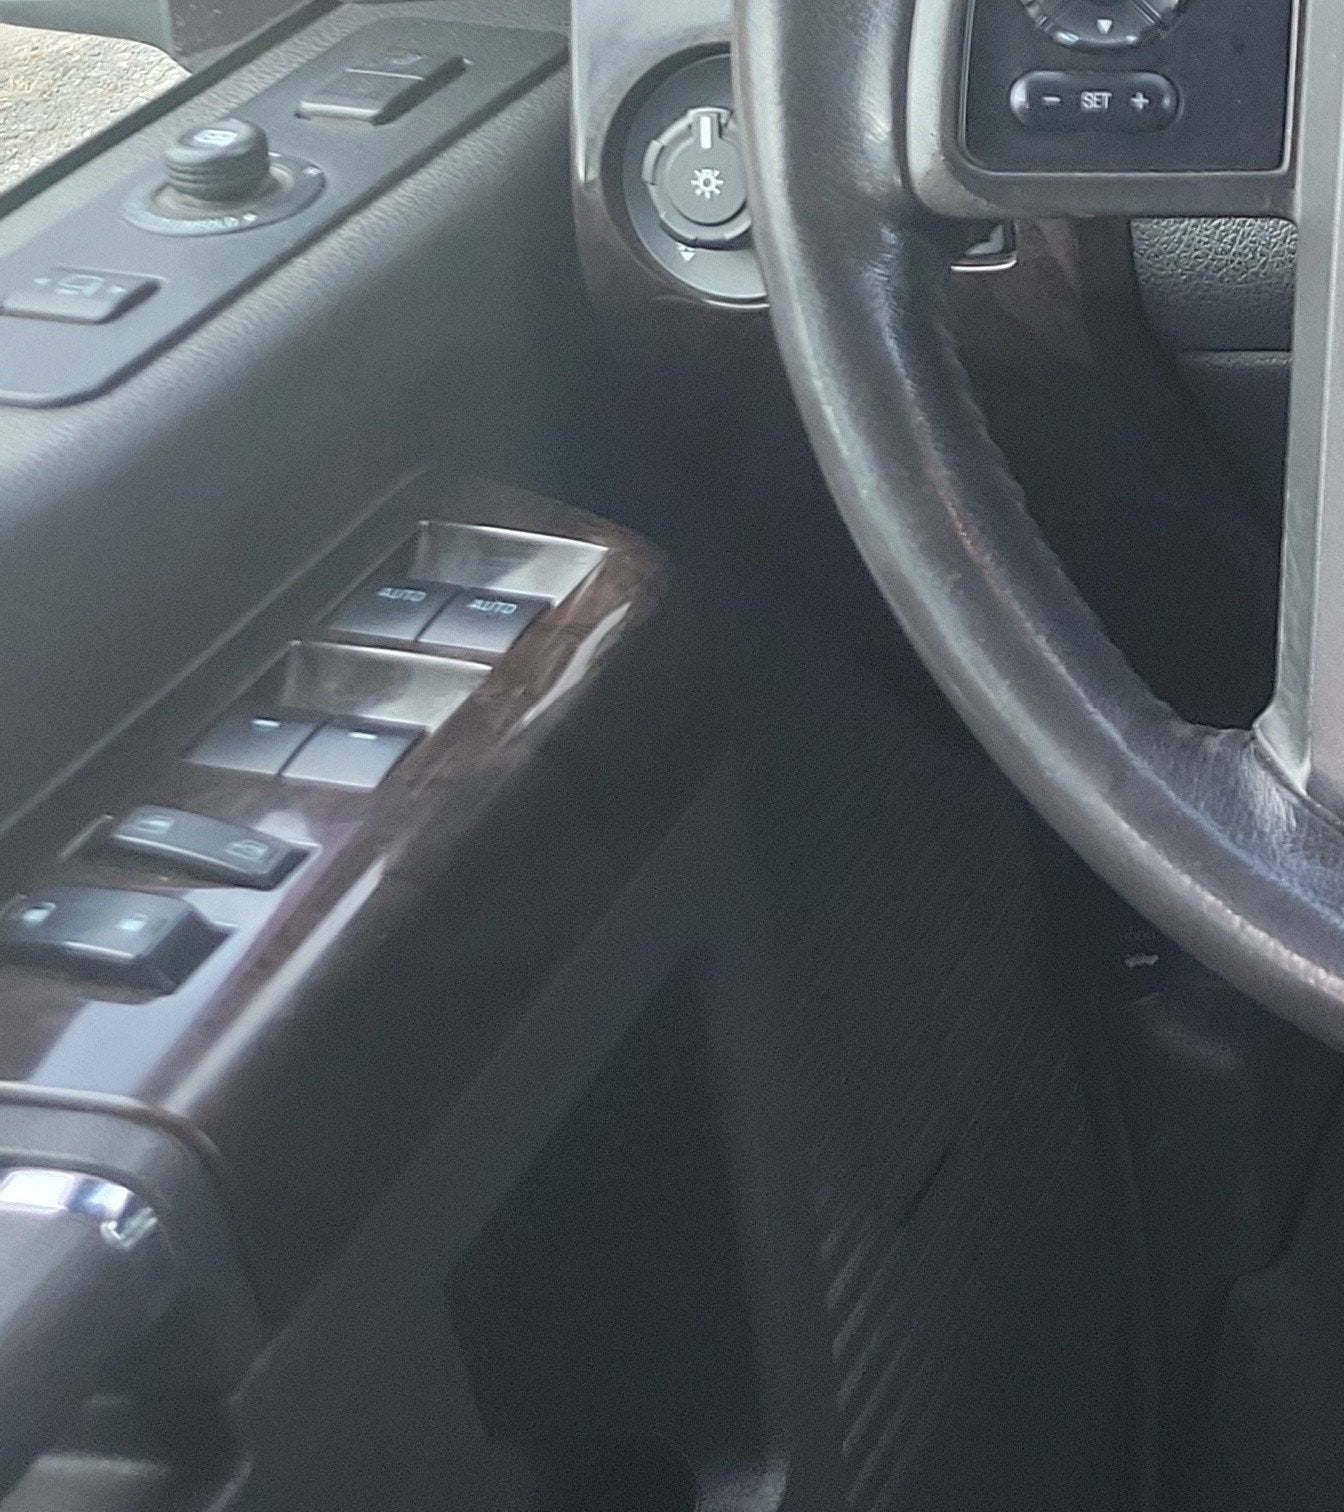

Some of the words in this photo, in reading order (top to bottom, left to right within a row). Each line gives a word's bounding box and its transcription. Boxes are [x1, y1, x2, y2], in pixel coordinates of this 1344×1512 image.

[1081, 92, 1112, 109] SET
[378, 588, 427, 602] AUTO
[467, 599, 518, 614] AUTO
